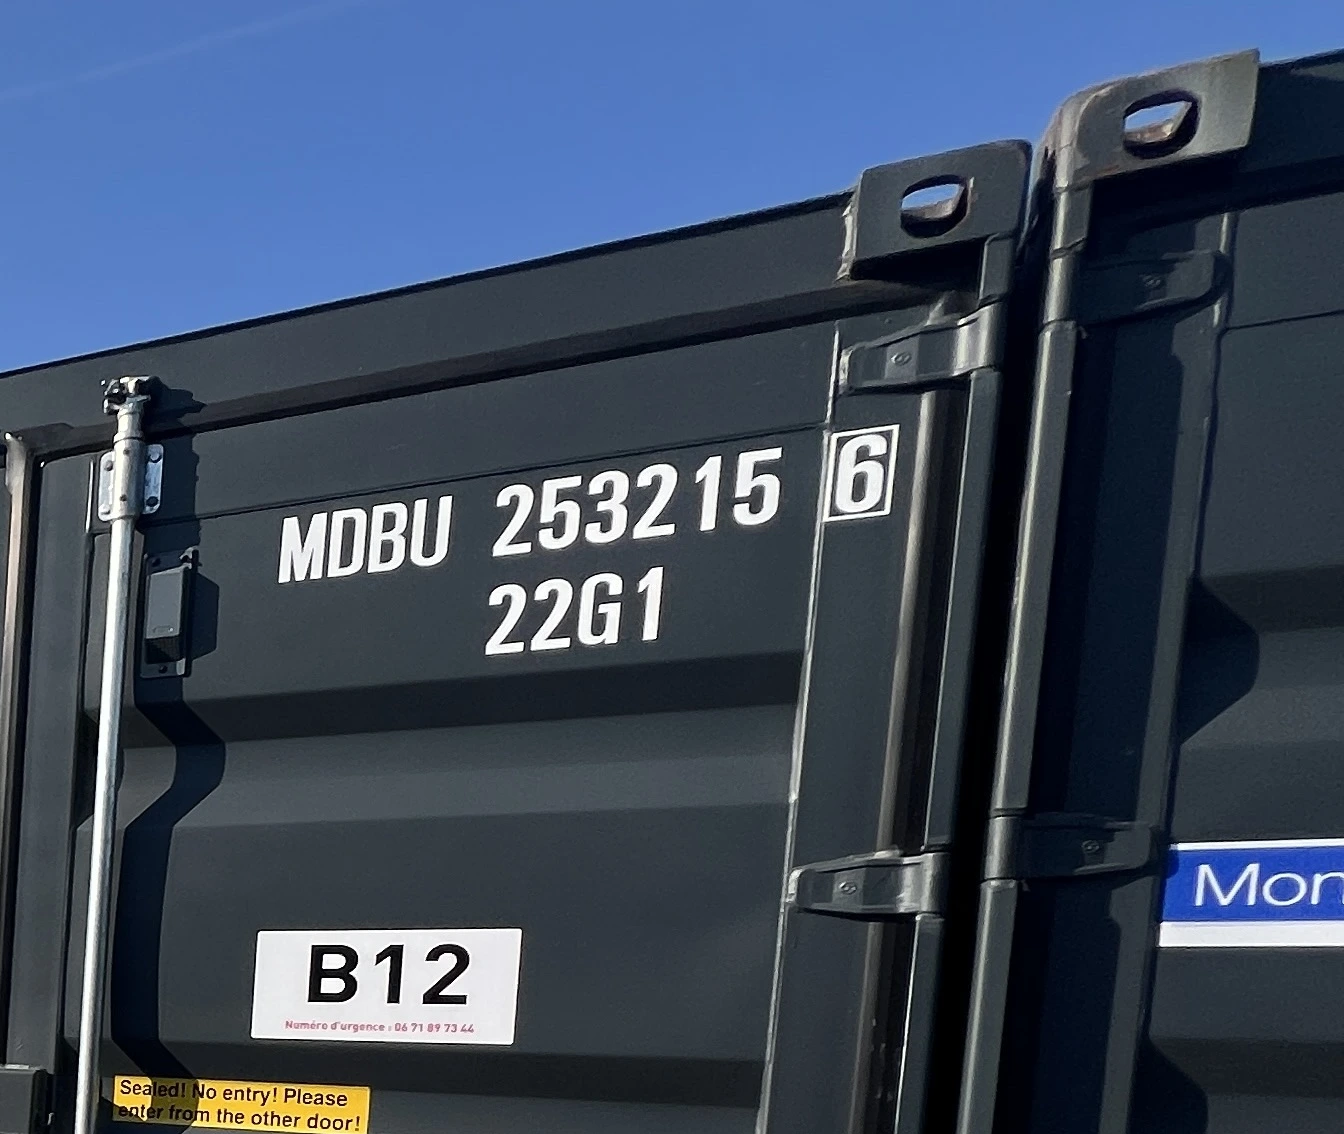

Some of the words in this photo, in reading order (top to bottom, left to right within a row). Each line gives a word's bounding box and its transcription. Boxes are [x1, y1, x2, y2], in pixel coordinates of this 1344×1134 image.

[277, 495, 453, 584] MDBU
[492, 447, 783, 560] 253215
[838, 435, 888, 514] 6
[485, 566, 665, 657] 22G1
[307, 943, 471, 1005] B12
[285, 1020, 328, 1031] Numéro
[330, 1020, 385, 1033] d'urgence
[394, 1022, 408, 1032] 06
[411, 1023, 424, 1033] 71
[427, 1023, 441, 1033] 89
[444, 1023, 457, 1033] 73
[120, 1079, 186, 1098] Sealed!
[192, 1083, 217, 1100] No
[223, 1086, 277, 1106] entry!
[284, 1087, 348, 1107] Please
[118, 1101, 162, 1120] enter
[168, 1104, 210, 1122] from
[217, 1106, 245, 1125] the
[251, 1109, 301, 1128] other
[307, 1113, 360, 1132] door!
